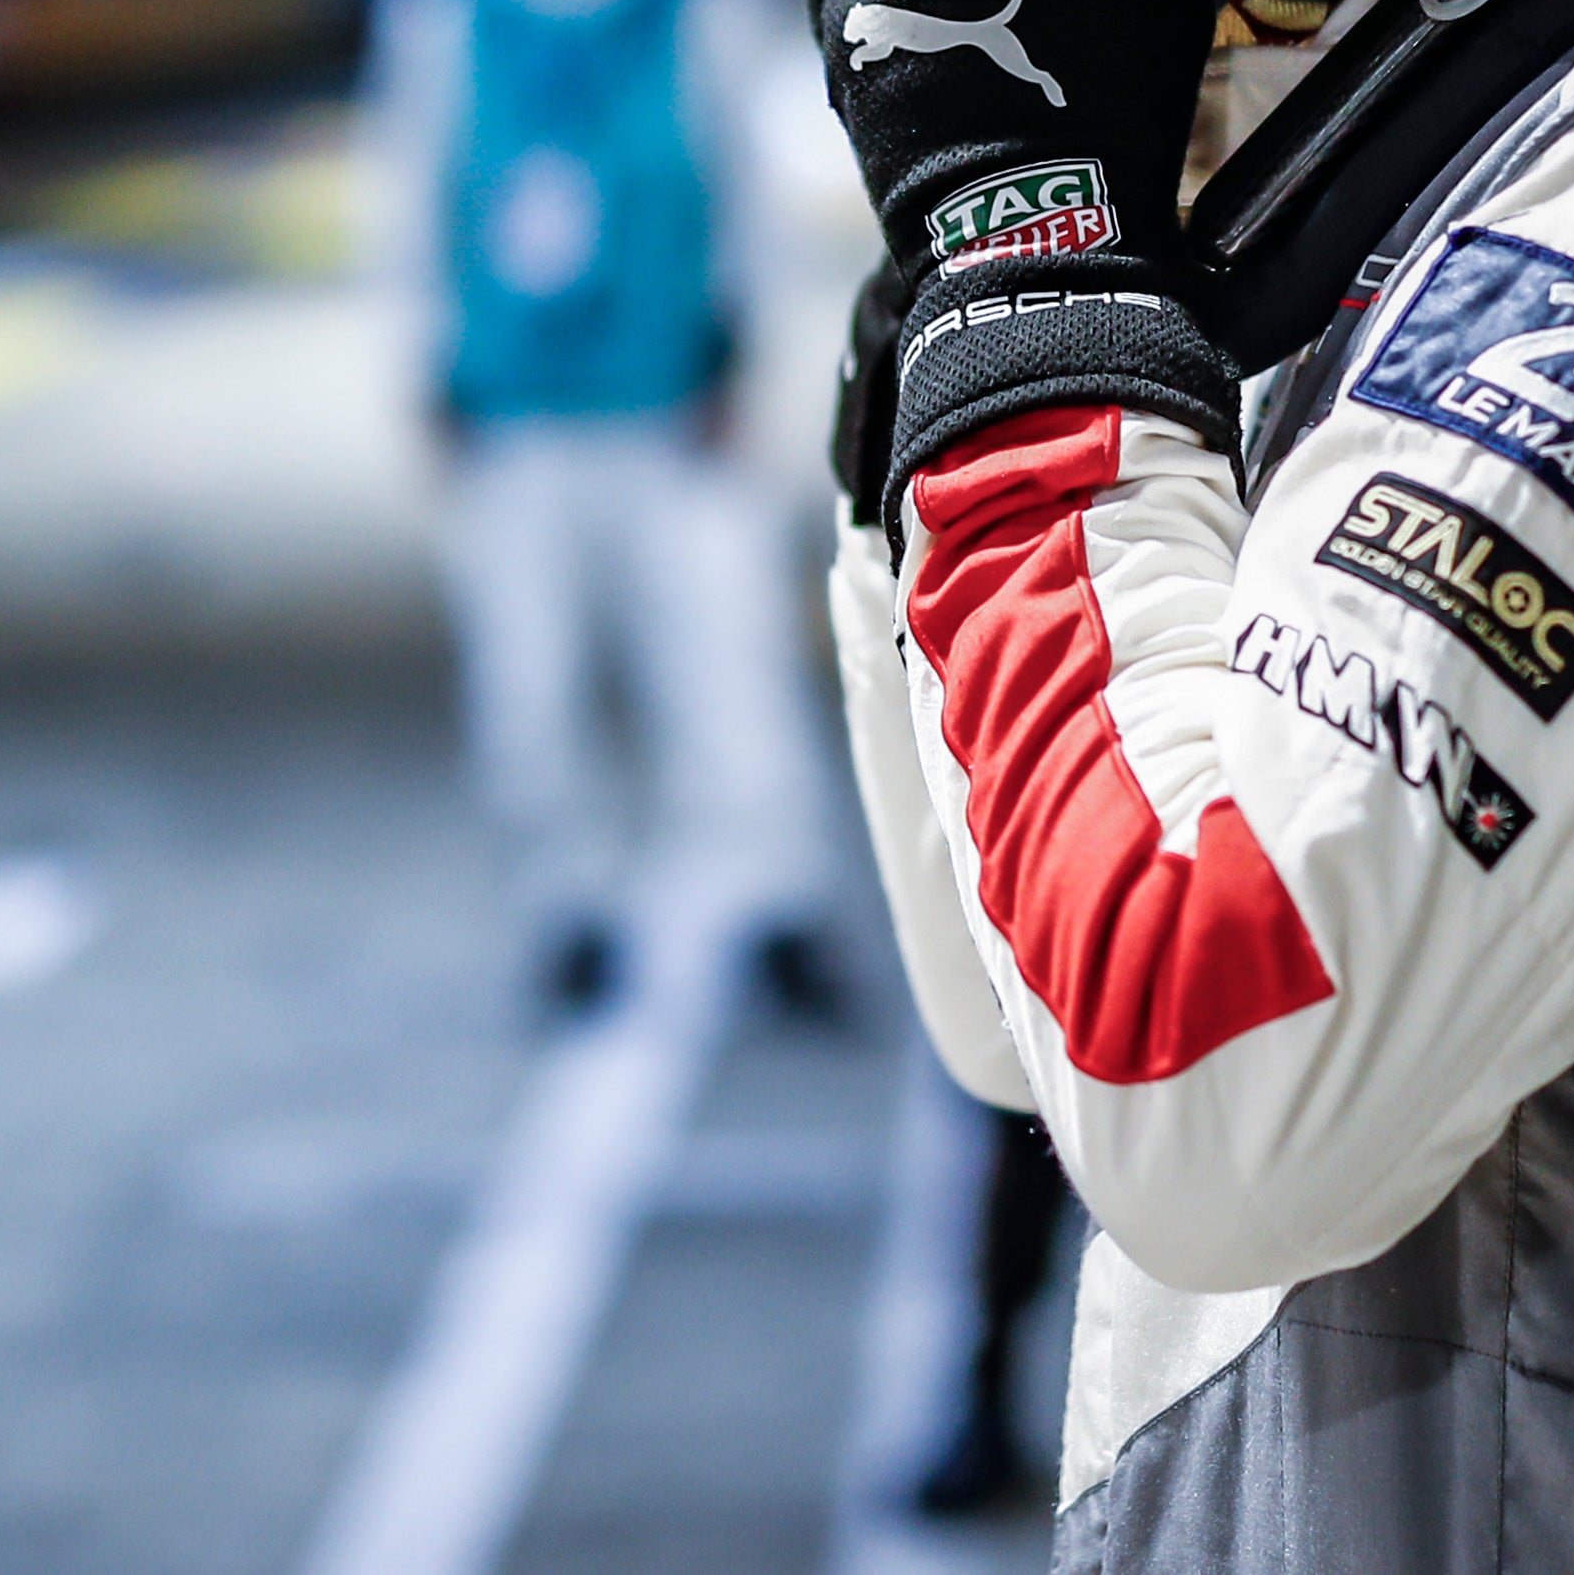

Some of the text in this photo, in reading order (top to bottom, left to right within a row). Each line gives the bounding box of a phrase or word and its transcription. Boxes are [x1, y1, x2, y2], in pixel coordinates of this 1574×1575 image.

[943, 175, 1083, 242] TAG
[899, 290, 1163, 394] ORSCHE
[1436, 375, 1512, 424] LE
[1231, 612, 1477, 827] HMW
